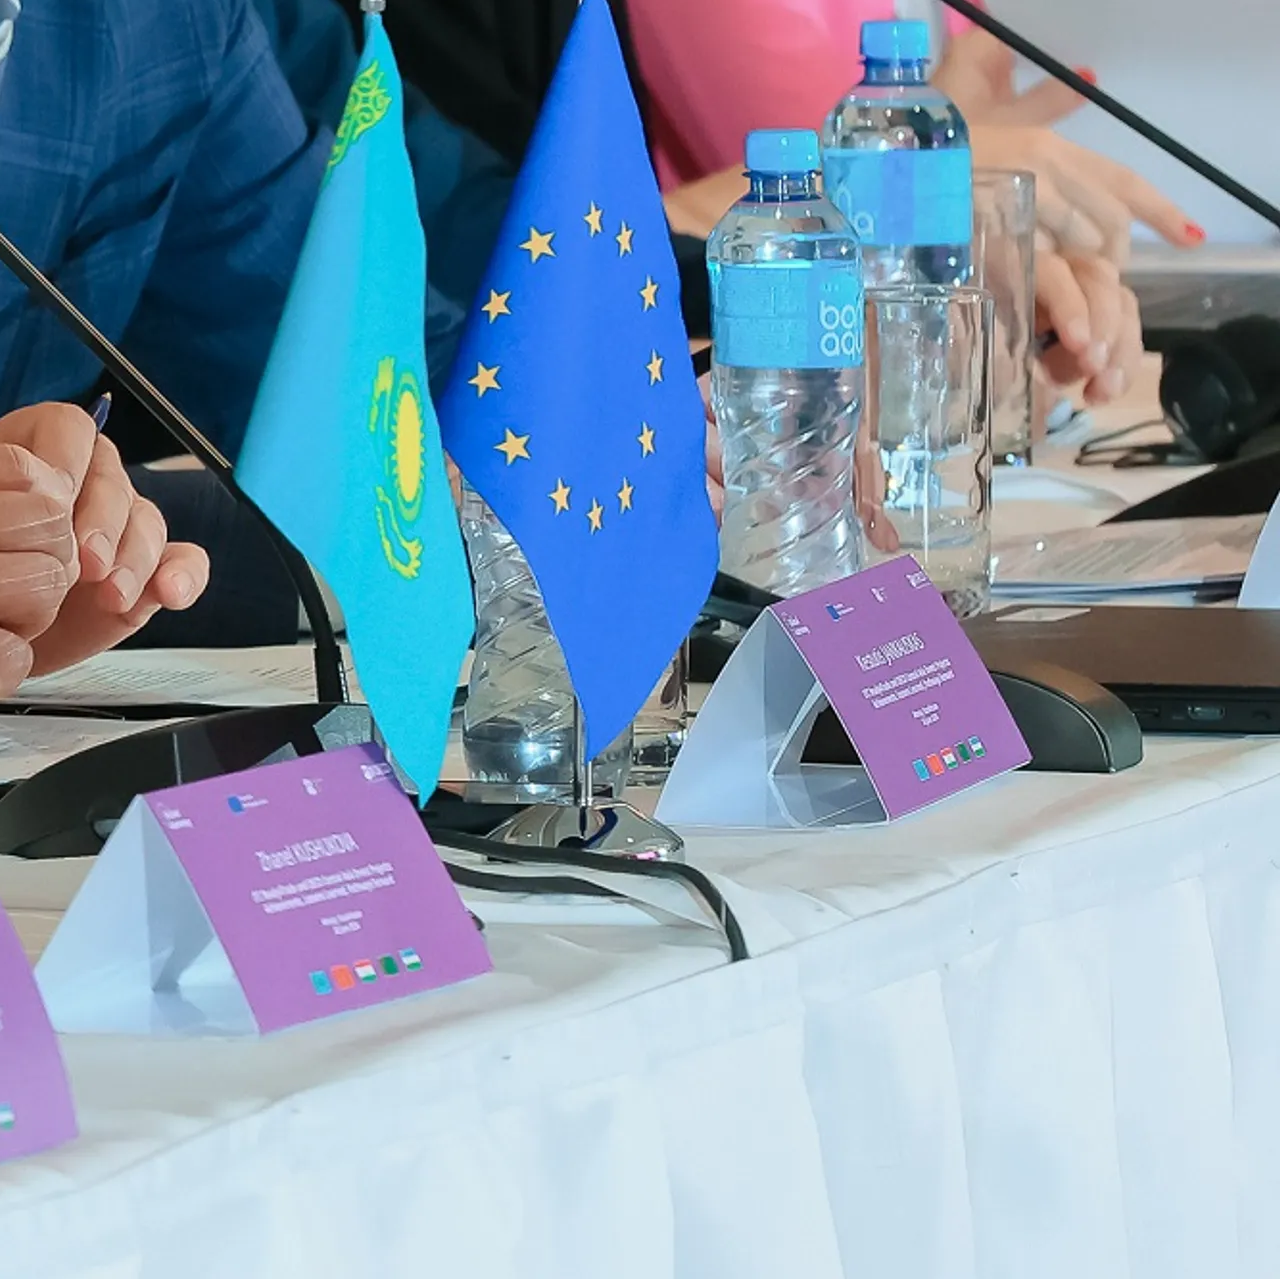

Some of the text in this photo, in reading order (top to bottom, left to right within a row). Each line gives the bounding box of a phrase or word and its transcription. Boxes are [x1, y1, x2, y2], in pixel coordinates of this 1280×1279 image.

[820, 331, 864, 361] aqu
[255, 833, 359, 871] Zhanel KUSHUKOVA
